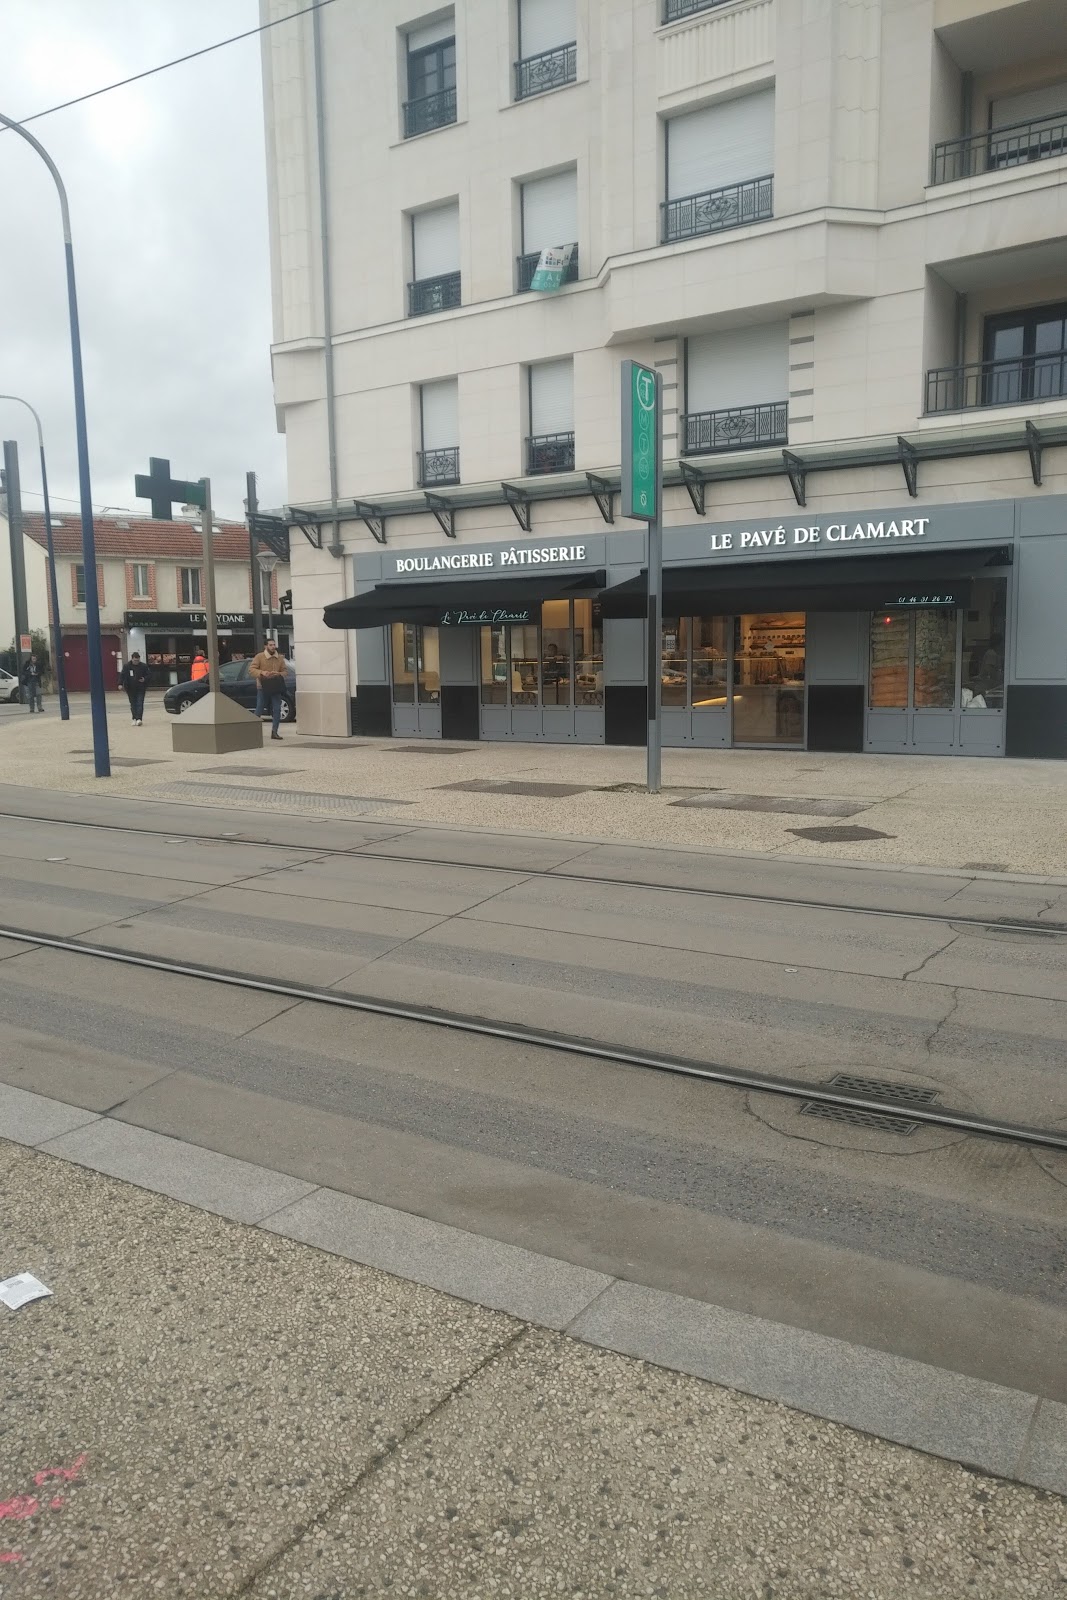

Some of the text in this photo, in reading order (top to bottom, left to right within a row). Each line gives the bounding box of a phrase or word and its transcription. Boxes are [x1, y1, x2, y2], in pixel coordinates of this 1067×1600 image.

[711, 518, 930, 550] LE PAVÉ DE CLAMART
[396, 546, 586, 572] BOULANGERIE PÂTISSERIE
[189, 614, 200, 622] LE
[441, 609, 529, 625] Le Pavé de Clamart
